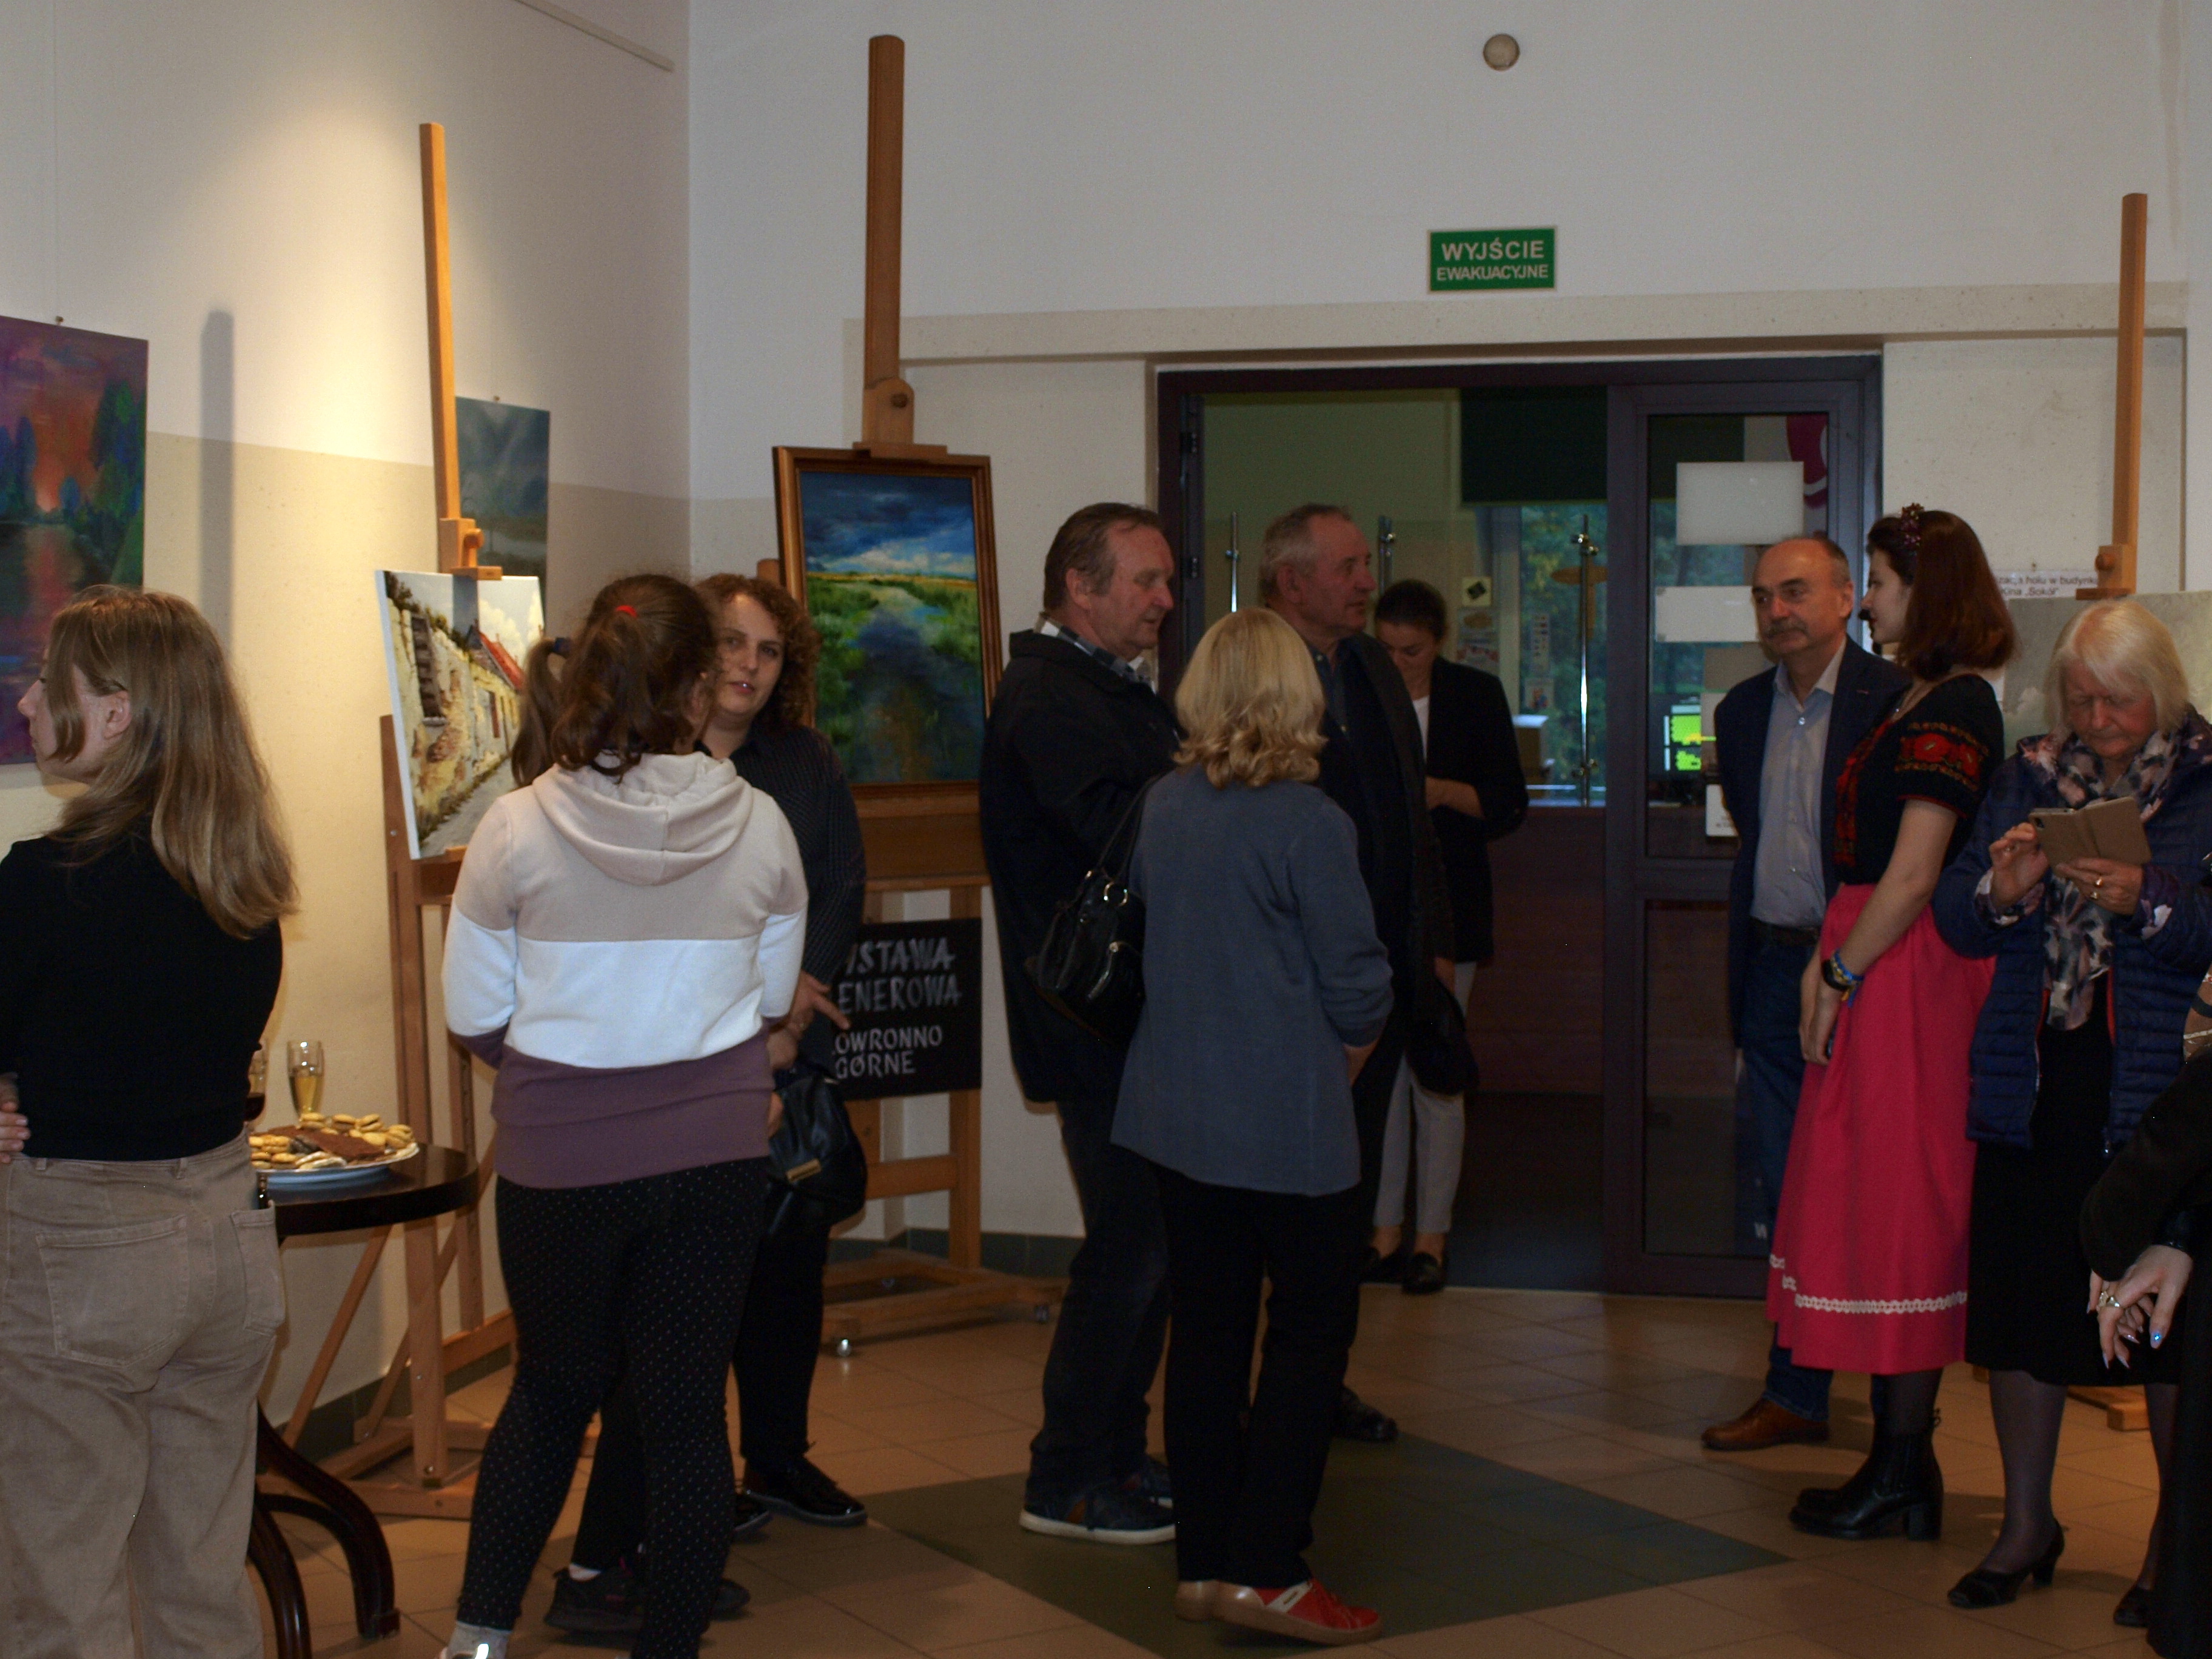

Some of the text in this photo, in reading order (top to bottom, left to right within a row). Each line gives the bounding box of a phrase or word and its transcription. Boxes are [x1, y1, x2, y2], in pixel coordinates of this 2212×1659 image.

[1441, 237, 1544, 261] WYJŚCIE
[1436, 264, 1549, 281] EWAKUACYJNE
[837, 973, 963, 1015] ENEROWA
[833, 1025, 943, 1056] OWRONNO
